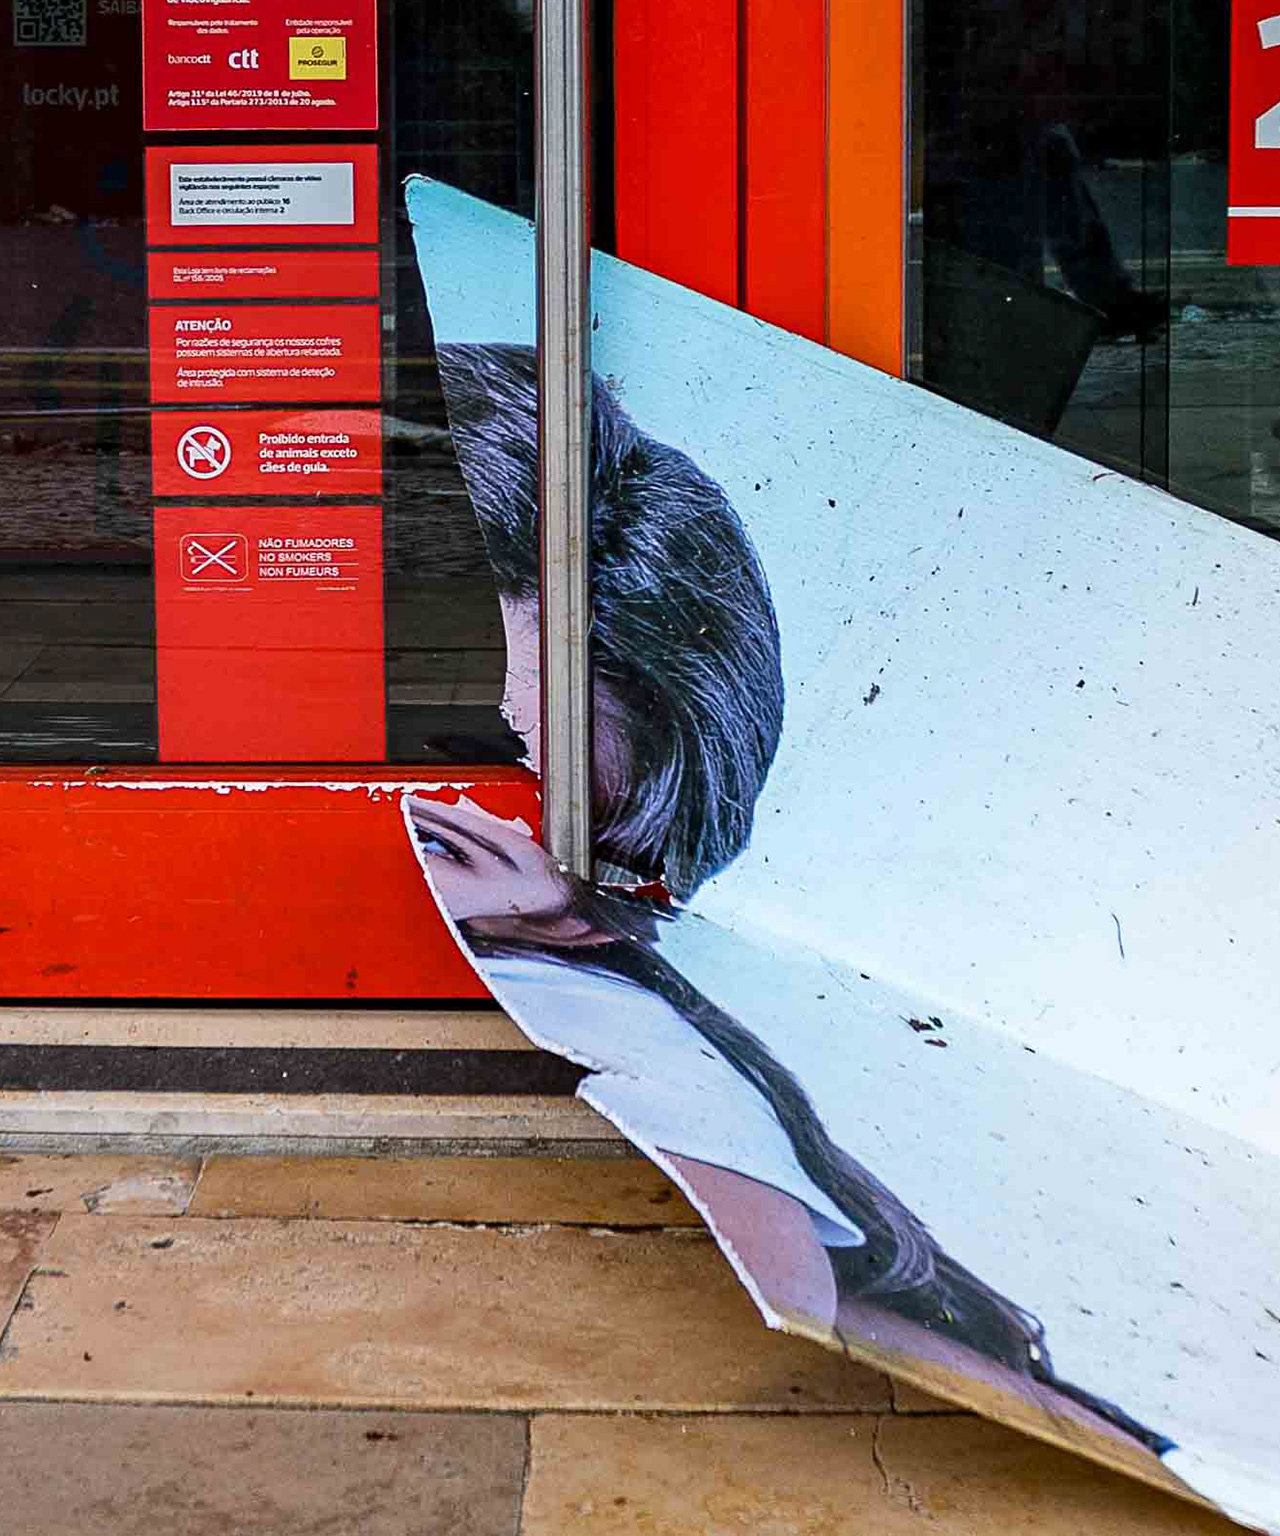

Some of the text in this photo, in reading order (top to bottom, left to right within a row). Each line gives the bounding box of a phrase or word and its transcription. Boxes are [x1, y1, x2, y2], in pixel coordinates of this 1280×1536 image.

[168, 54, 211, 64] bancoctt
[228, 49, 259, 69] ctt
[22, 83, 119, 112] locky.pt
[175, 318, 232, 333] ATENÇÃO
[307, 434, 349, 443] entrada
[259, 448, 357, 458] de animais exceto
[260, 462, 329, 474] cães de guia.
[259, 538, 353, 548] NÃO FUMADORES
[259, 553, 331, 562] NO SMOKERS
[259, 567, 339, 576] NON FUMEURS
